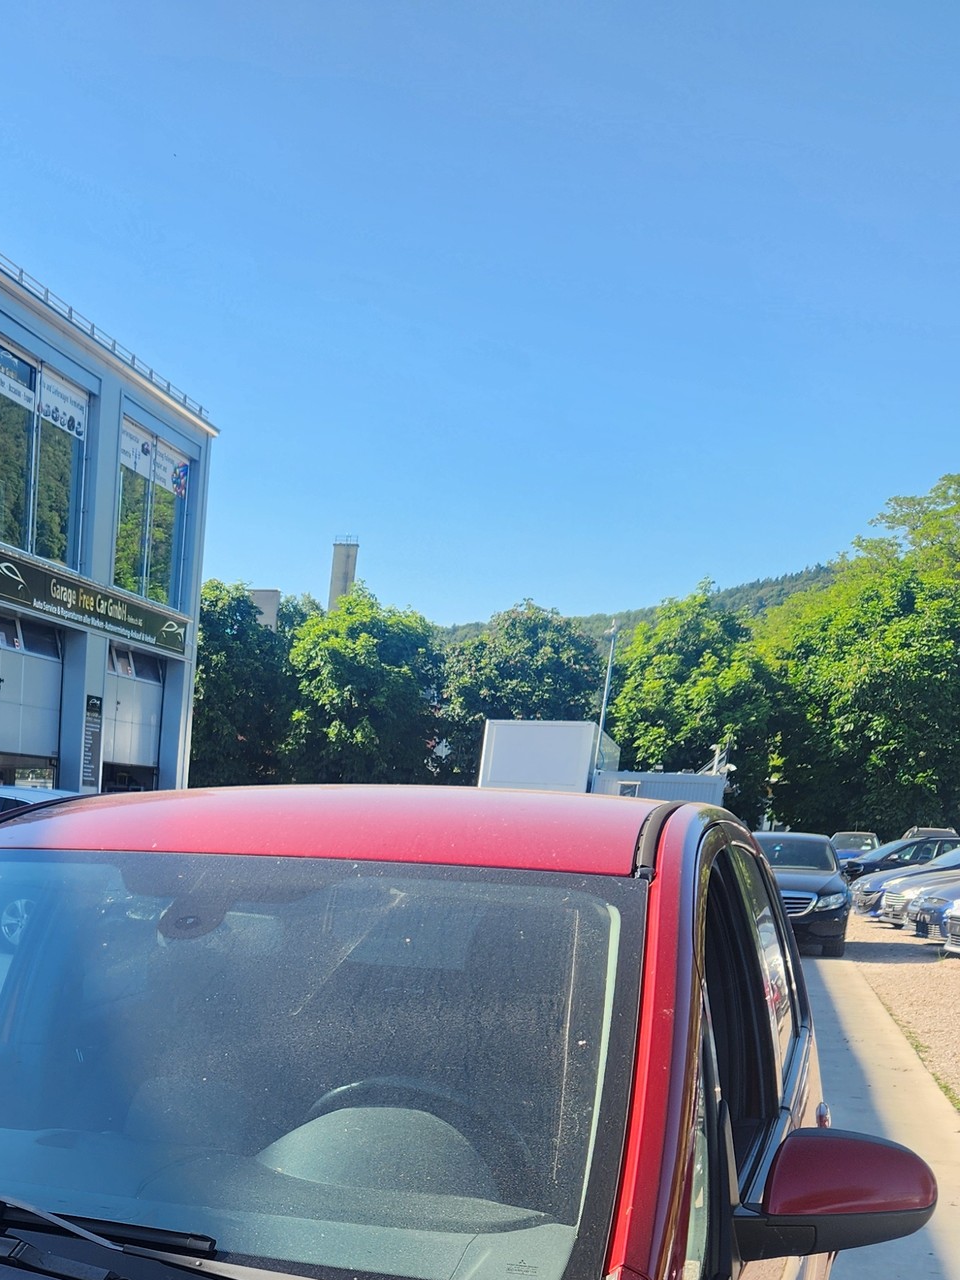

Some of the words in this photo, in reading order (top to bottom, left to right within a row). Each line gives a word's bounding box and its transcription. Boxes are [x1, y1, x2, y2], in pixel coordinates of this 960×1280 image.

[50, 579, 77, 608] Garage
[78, 588, 94, 611] Free
[95, 594, 107, 614] Car
[107, 598, 127, 622] GmbH
